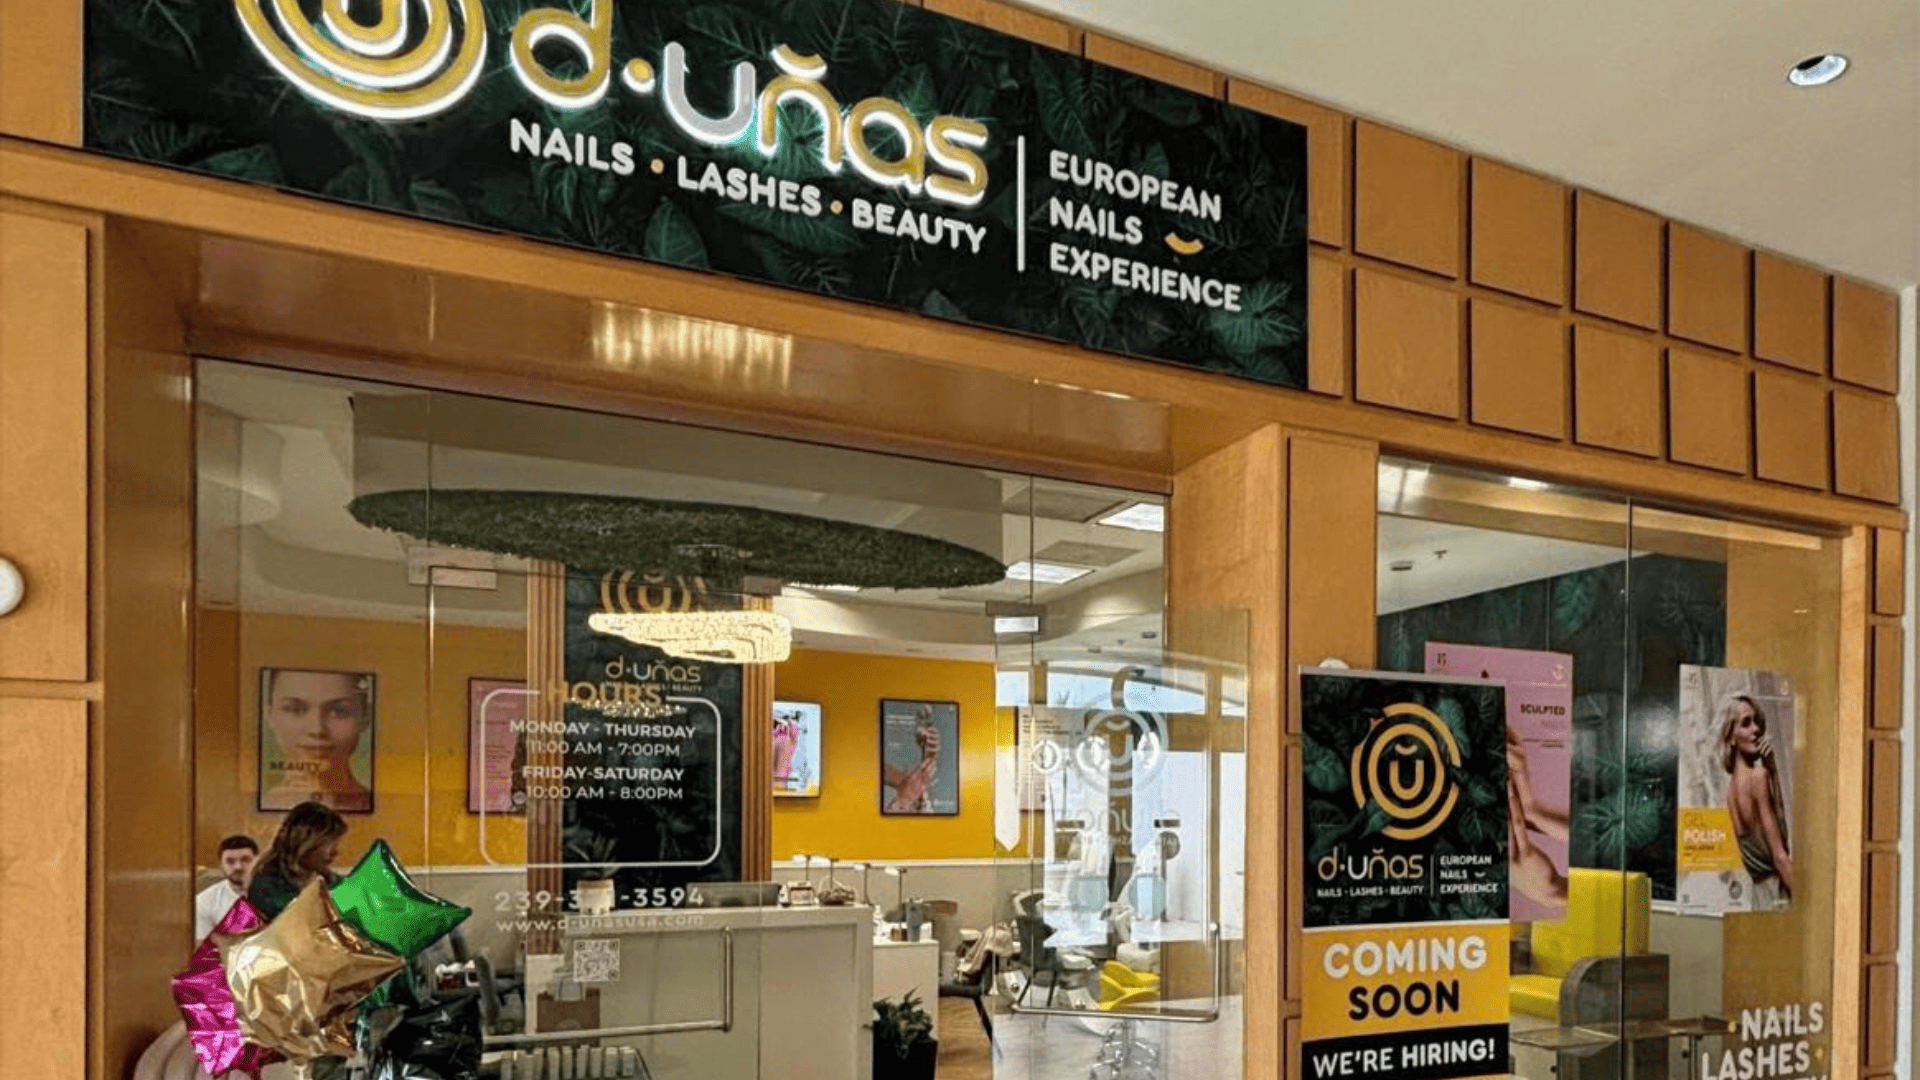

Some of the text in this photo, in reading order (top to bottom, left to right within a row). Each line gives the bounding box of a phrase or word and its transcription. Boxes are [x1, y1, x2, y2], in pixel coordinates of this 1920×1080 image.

[510, 118, 987, 253] NAILS LASHES BEAUTY
[1050, 150, 1221, 223] EUROPEAN
[1050, 197, 1143, 246] NAILS
[1050, 242, 1242, 312] EXPERIENCE
[1520, 703, 1566, 716] SCULPTED
[510, 719, 591, 735] MONDAY
[604, 722, 697, 739] THURSDAY
[526, 740, 569, 754] 11:00
[573, 741, 602, 755] AM
[617, 743, 680, 757] 7:00PM
[526, 786, 570, 799] 10:00
[575, 787, 604, 799] AM
[620, 787, 683, 799] 8:00PM
[1439, 855, 1492, 866] EUROPEAN
[1439, 869, 1468, 880] NAILS
[494, 887, 704, 911] 239-3-3594
[1317, 885, 1424, 898] NAILS LASHES BEAUTY
[1439, 882, 1499, 894] EXPERIENCE
[1323, 935, 1488, 978] COMING
[1348, 979, 1460, 1021] SOON
[1741, 1002, 1824, 1041] NAILS
[1313, 1038, 1496, 1078] WE'RE HIRING!
[1702, 1040, 1810, 1080] LASHES
